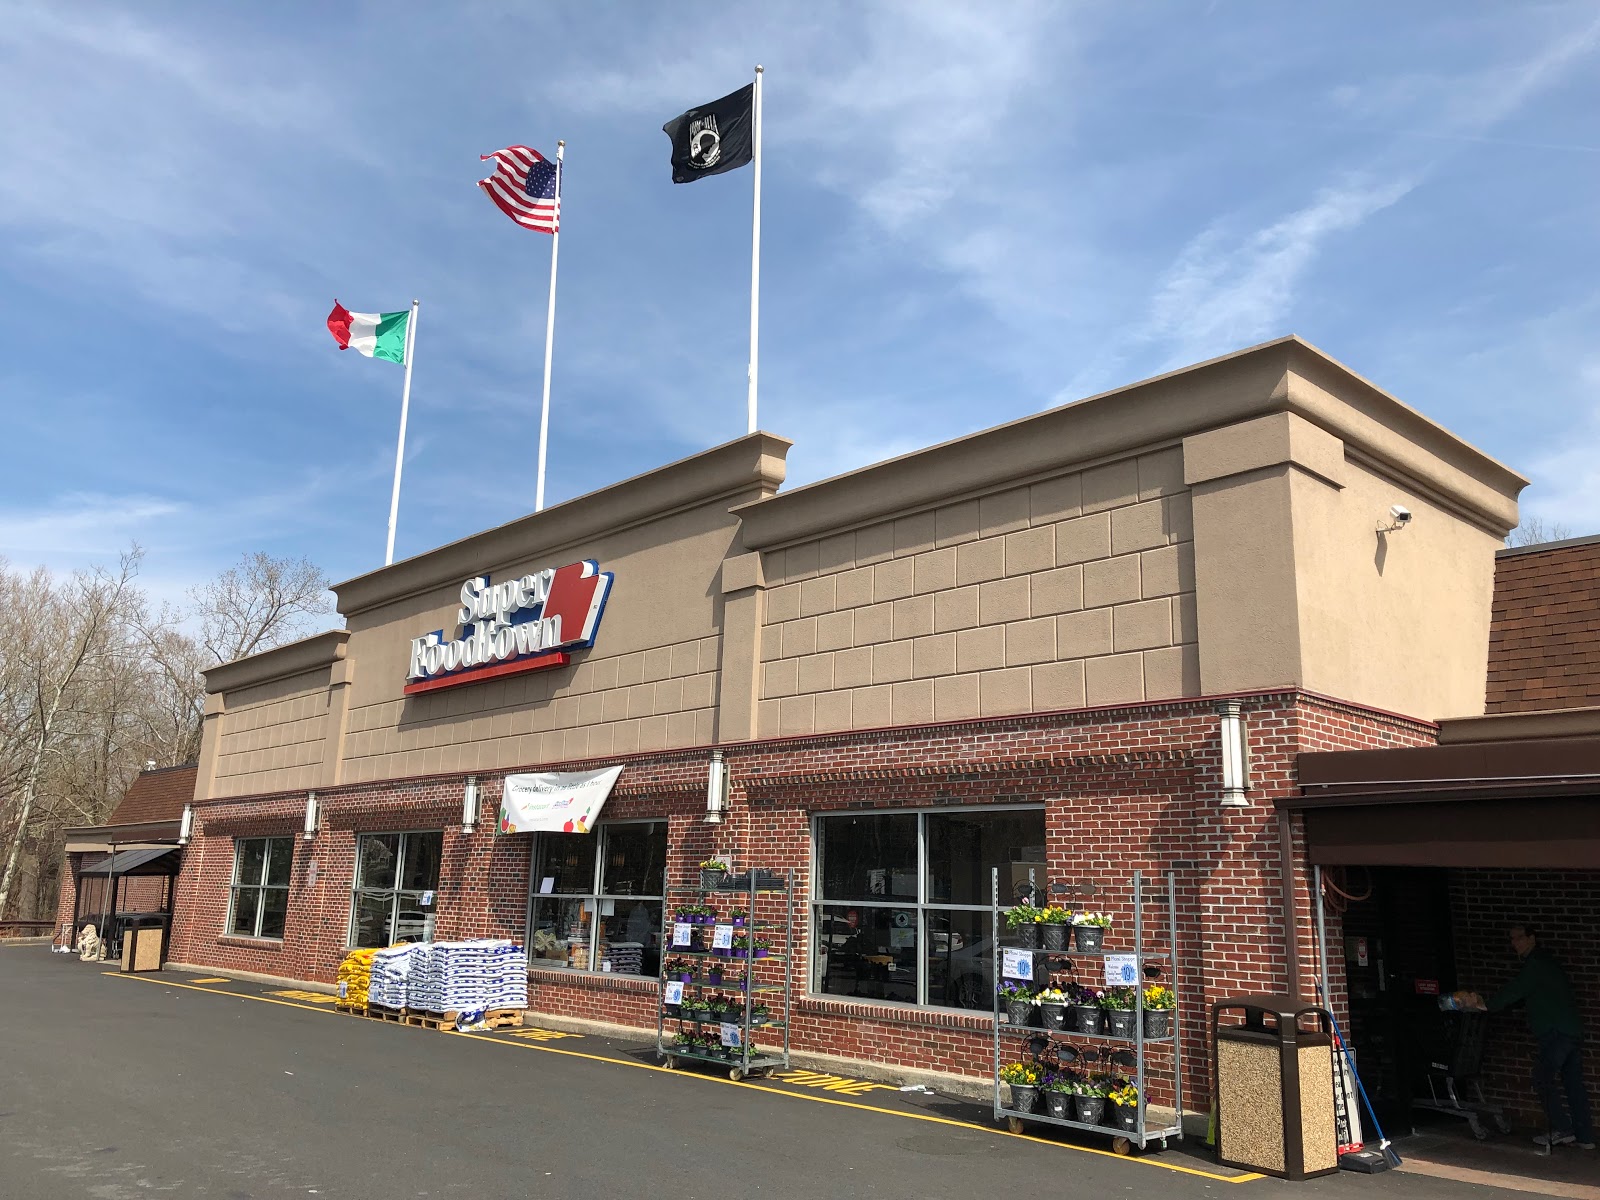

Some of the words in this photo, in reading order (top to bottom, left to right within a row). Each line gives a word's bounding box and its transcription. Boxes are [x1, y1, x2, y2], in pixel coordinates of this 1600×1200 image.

[458, 568, 553, 627] Super
[406, 614, 563, 680] Foodtown
[512, 785, 532, 794] Grocery
[532, 784, 553, 794] delivery
